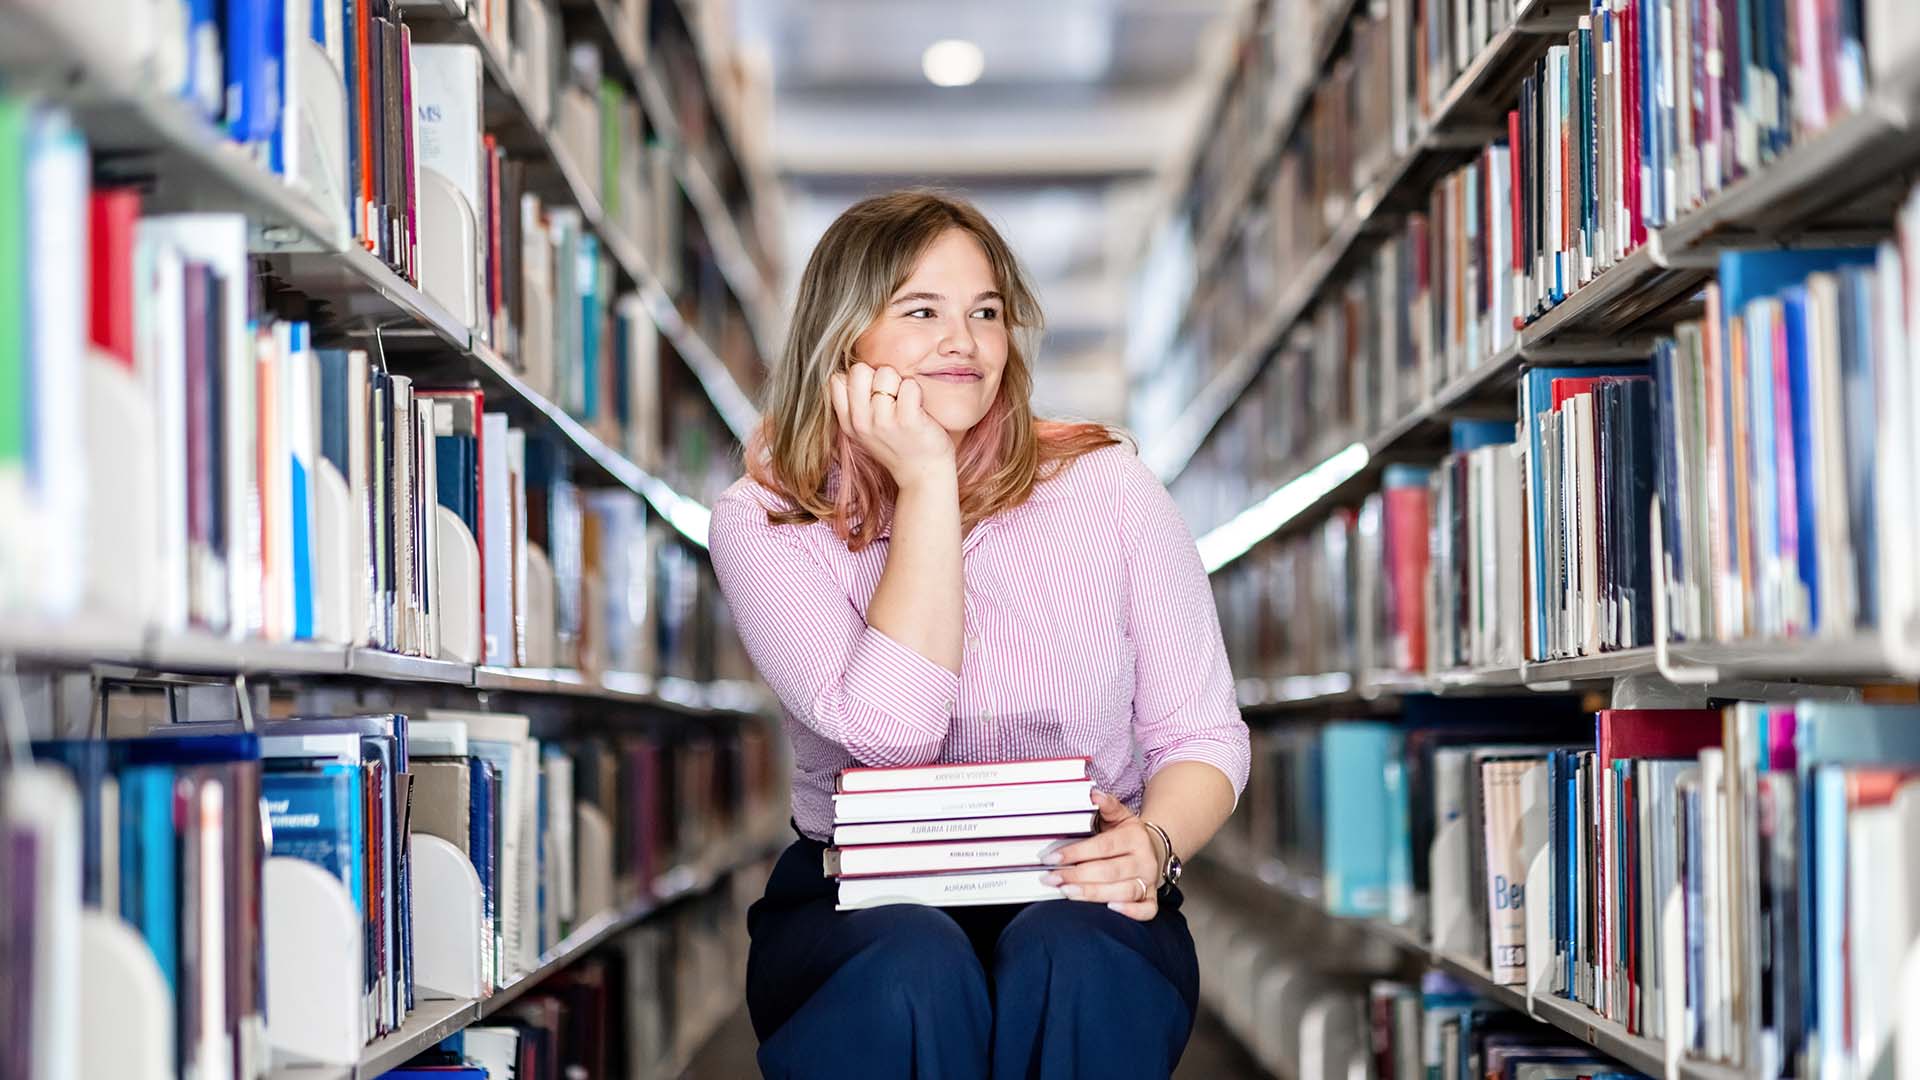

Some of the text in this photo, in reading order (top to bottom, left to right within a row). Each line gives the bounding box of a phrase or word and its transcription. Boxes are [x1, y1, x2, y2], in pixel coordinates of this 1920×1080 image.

[911, 823, 978, 834] AURARIA LIBRARY
[944, 882, 977, 892] AURARIA
